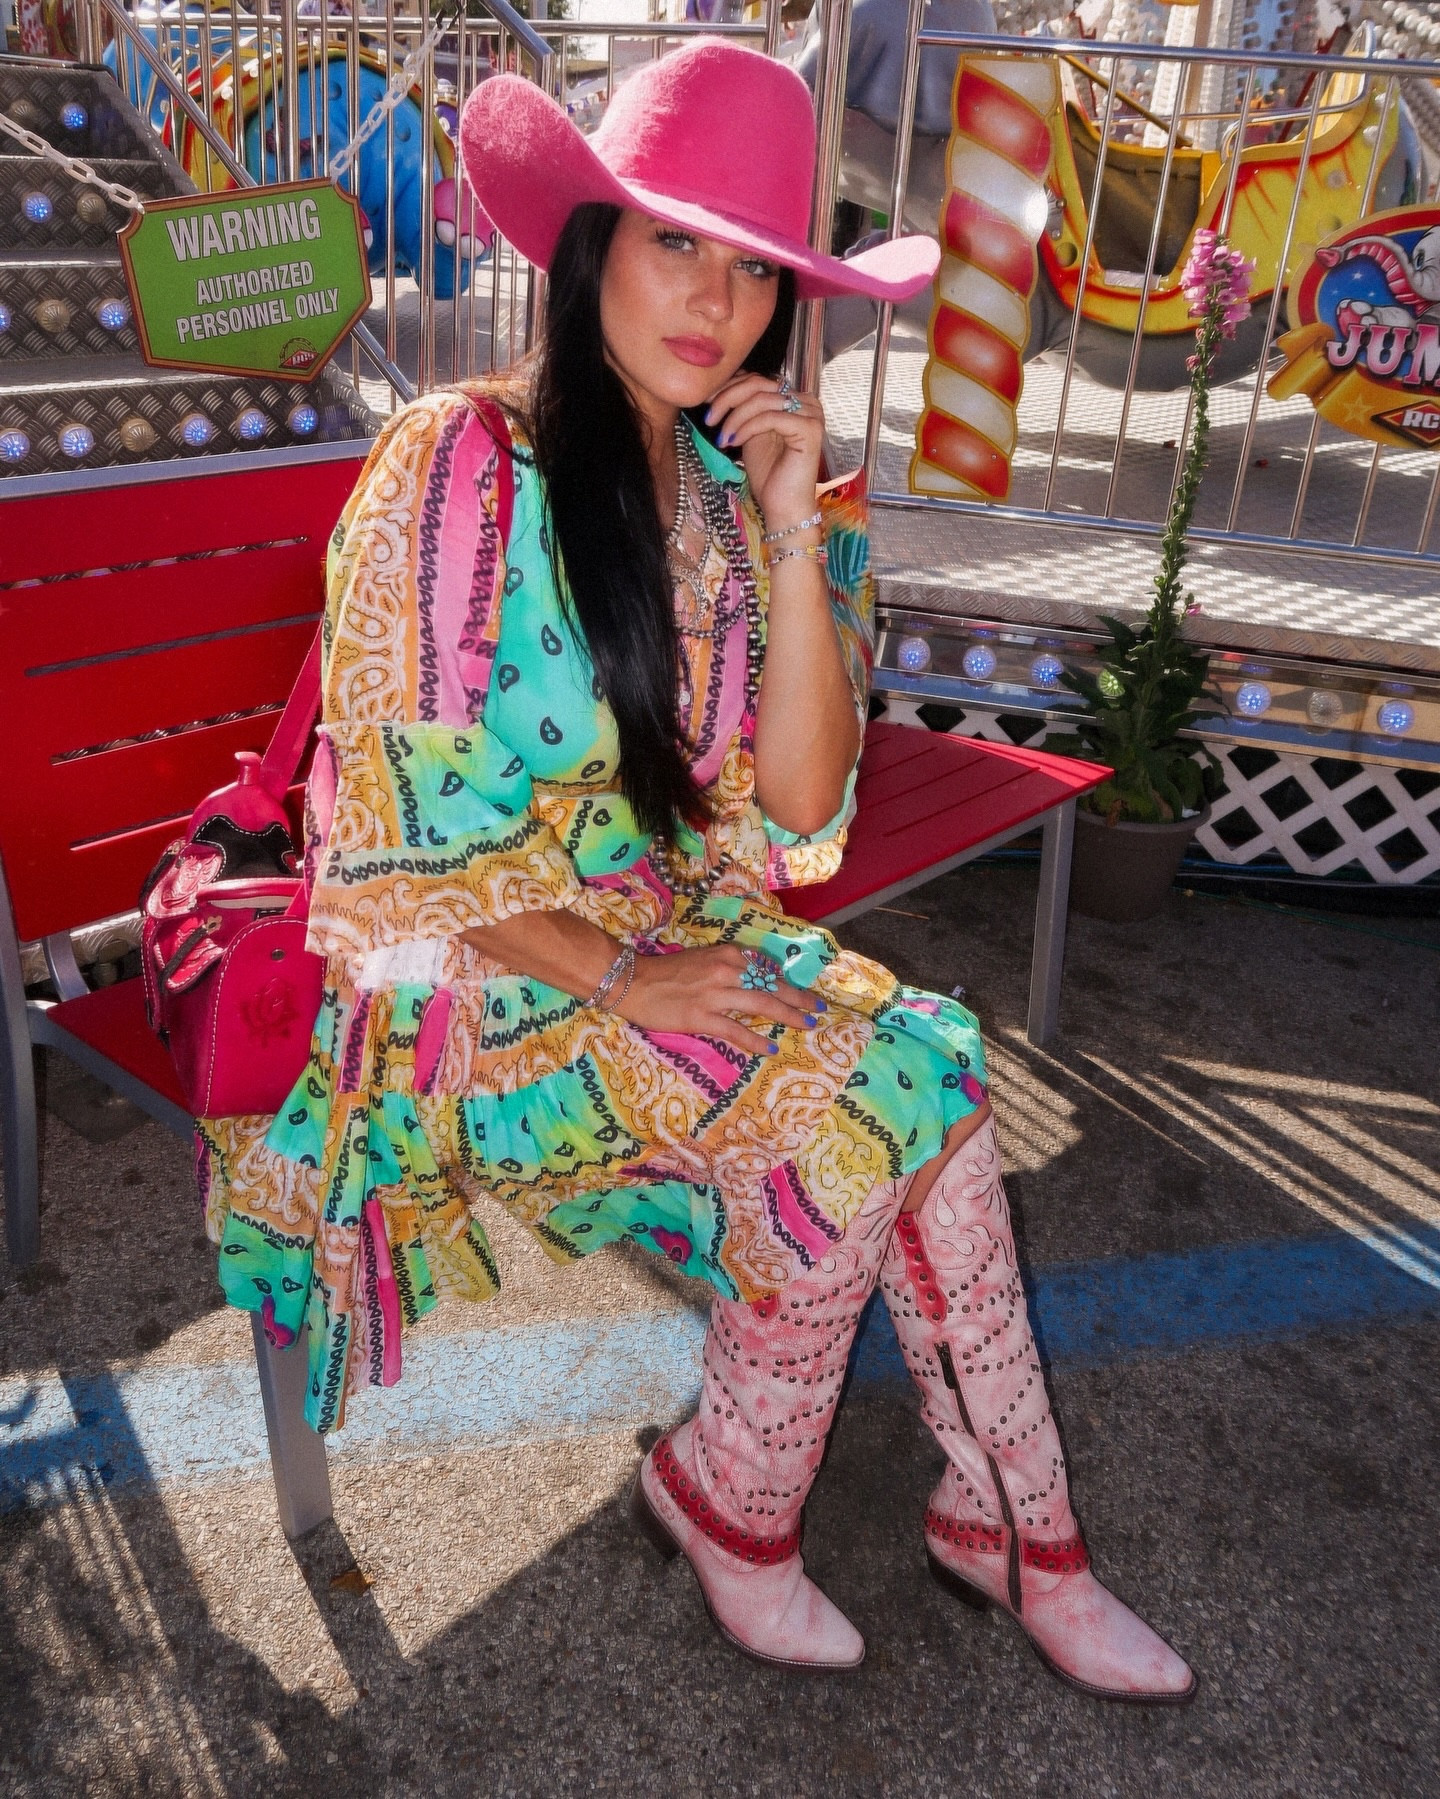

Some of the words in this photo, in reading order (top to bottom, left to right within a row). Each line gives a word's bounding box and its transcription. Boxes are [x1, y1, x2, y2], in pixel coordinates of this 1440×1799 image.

[165, 198, 321, 262] WARNING
[196, 260, 314, 306] AUTHORIZED
[176, 298, 292, 344] PERSONNEL
[295, 287, 339, 319] ONLY
